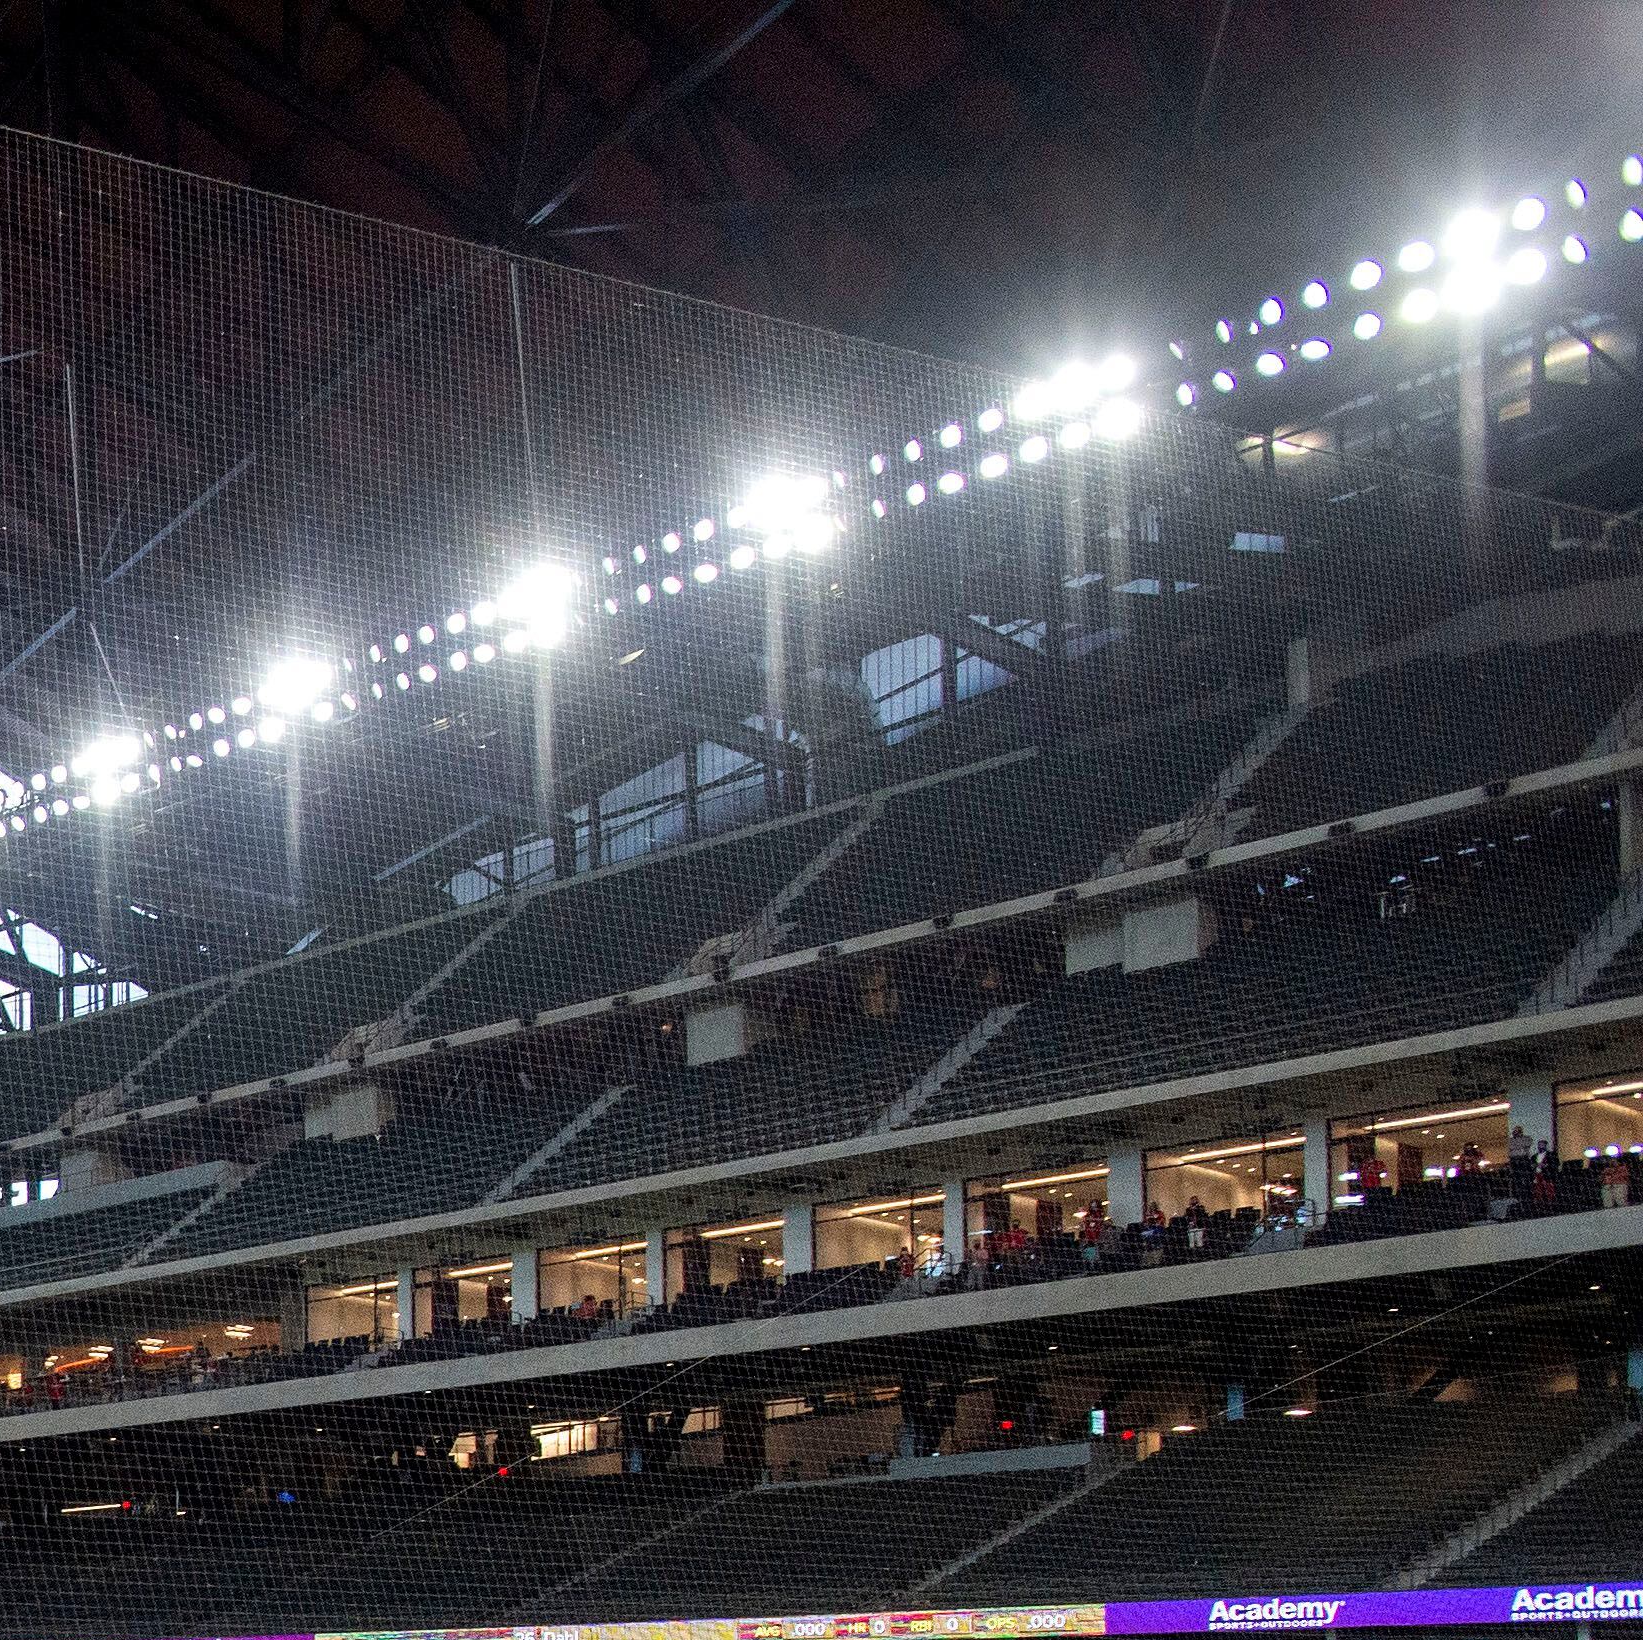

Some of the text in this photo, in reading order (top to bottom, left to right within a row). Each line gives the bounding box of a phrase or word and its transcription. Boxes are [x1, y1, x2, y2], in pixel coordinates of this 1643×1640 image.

[1512, 1586, 1643, 1612] Academ
[1209, 1598, 1339, 1624] Academy
[848, 1621, 886, 1635] HR 0
[911, 1618, 958, 1632] RBI 0
[987, 1614, 1065, 1630] OPS .000
[755, 1623, 826, 1638] AVG .000
